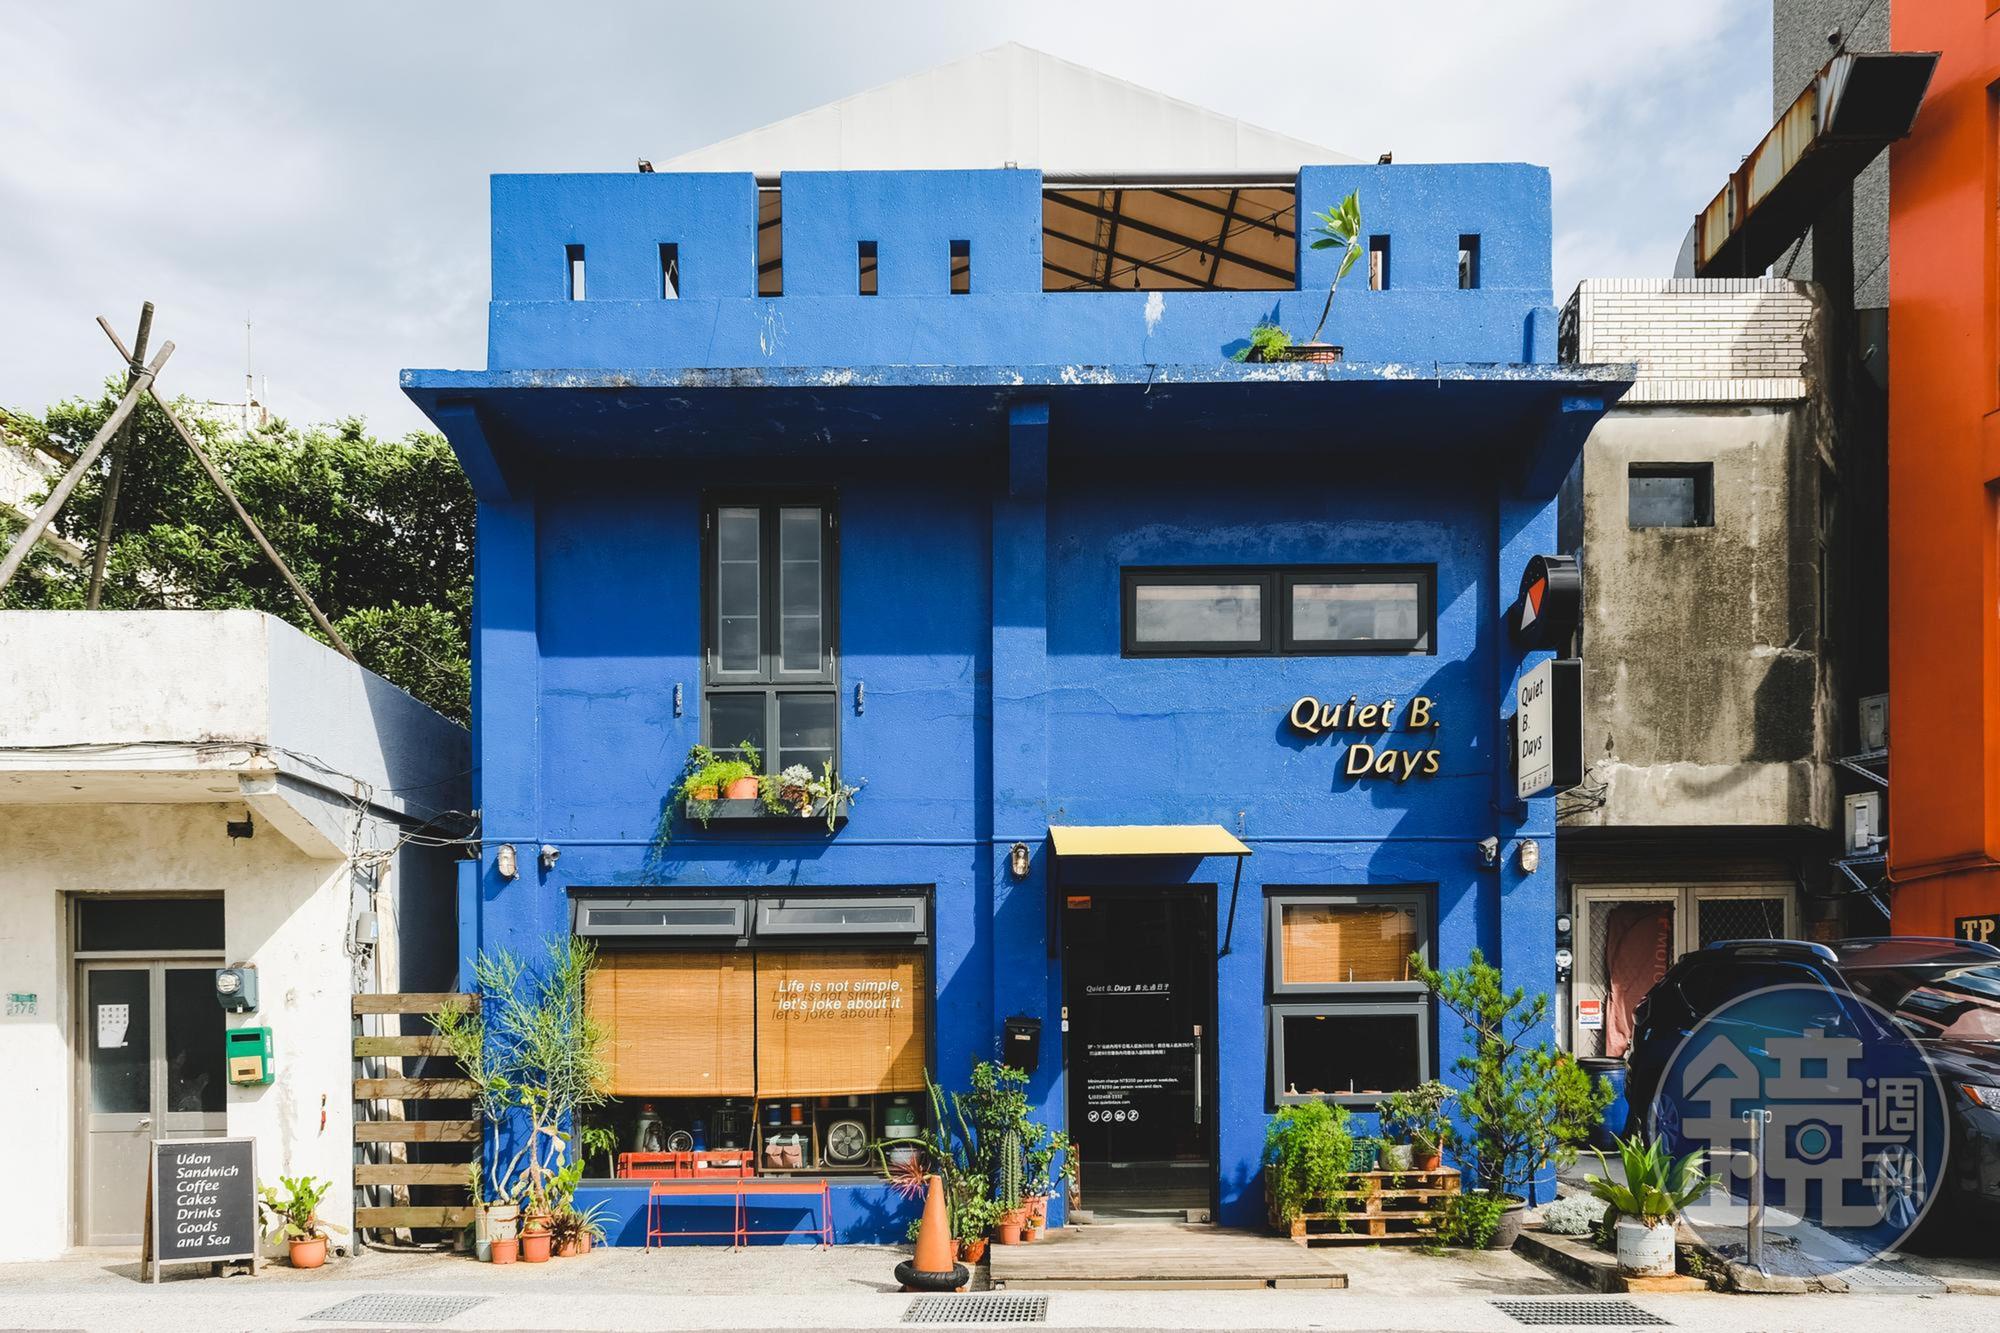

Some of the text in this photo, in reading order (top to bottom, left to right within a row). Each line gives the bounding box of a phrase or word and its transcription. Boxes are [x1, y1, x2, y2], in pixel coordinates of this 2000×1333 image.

[1521, 678, 1544, 707] Quiet
[1290, 694, 1440, 733] Quiet B.
[1521, 735, 1542, 758] Days
[1346, 744, 1441, 781] Days
[778, 979, 903, 994] Life is not simple,
[1114, 984, 1131, 993] Days
[778, 997, 904, 1012] let's joke about it.
[176, 1153, 211, 1165] Udon
[176, 1165, 239, 1179] Sandwich
[176, 1180, 220, 1193] Coffee
[176, 1193, 217, 1206] Cakes
[176, 1207, 222, 1220] Drinks
[176, 1220, 218, 1234] Goods
[176, 1234, 231, 1248] and Sea
